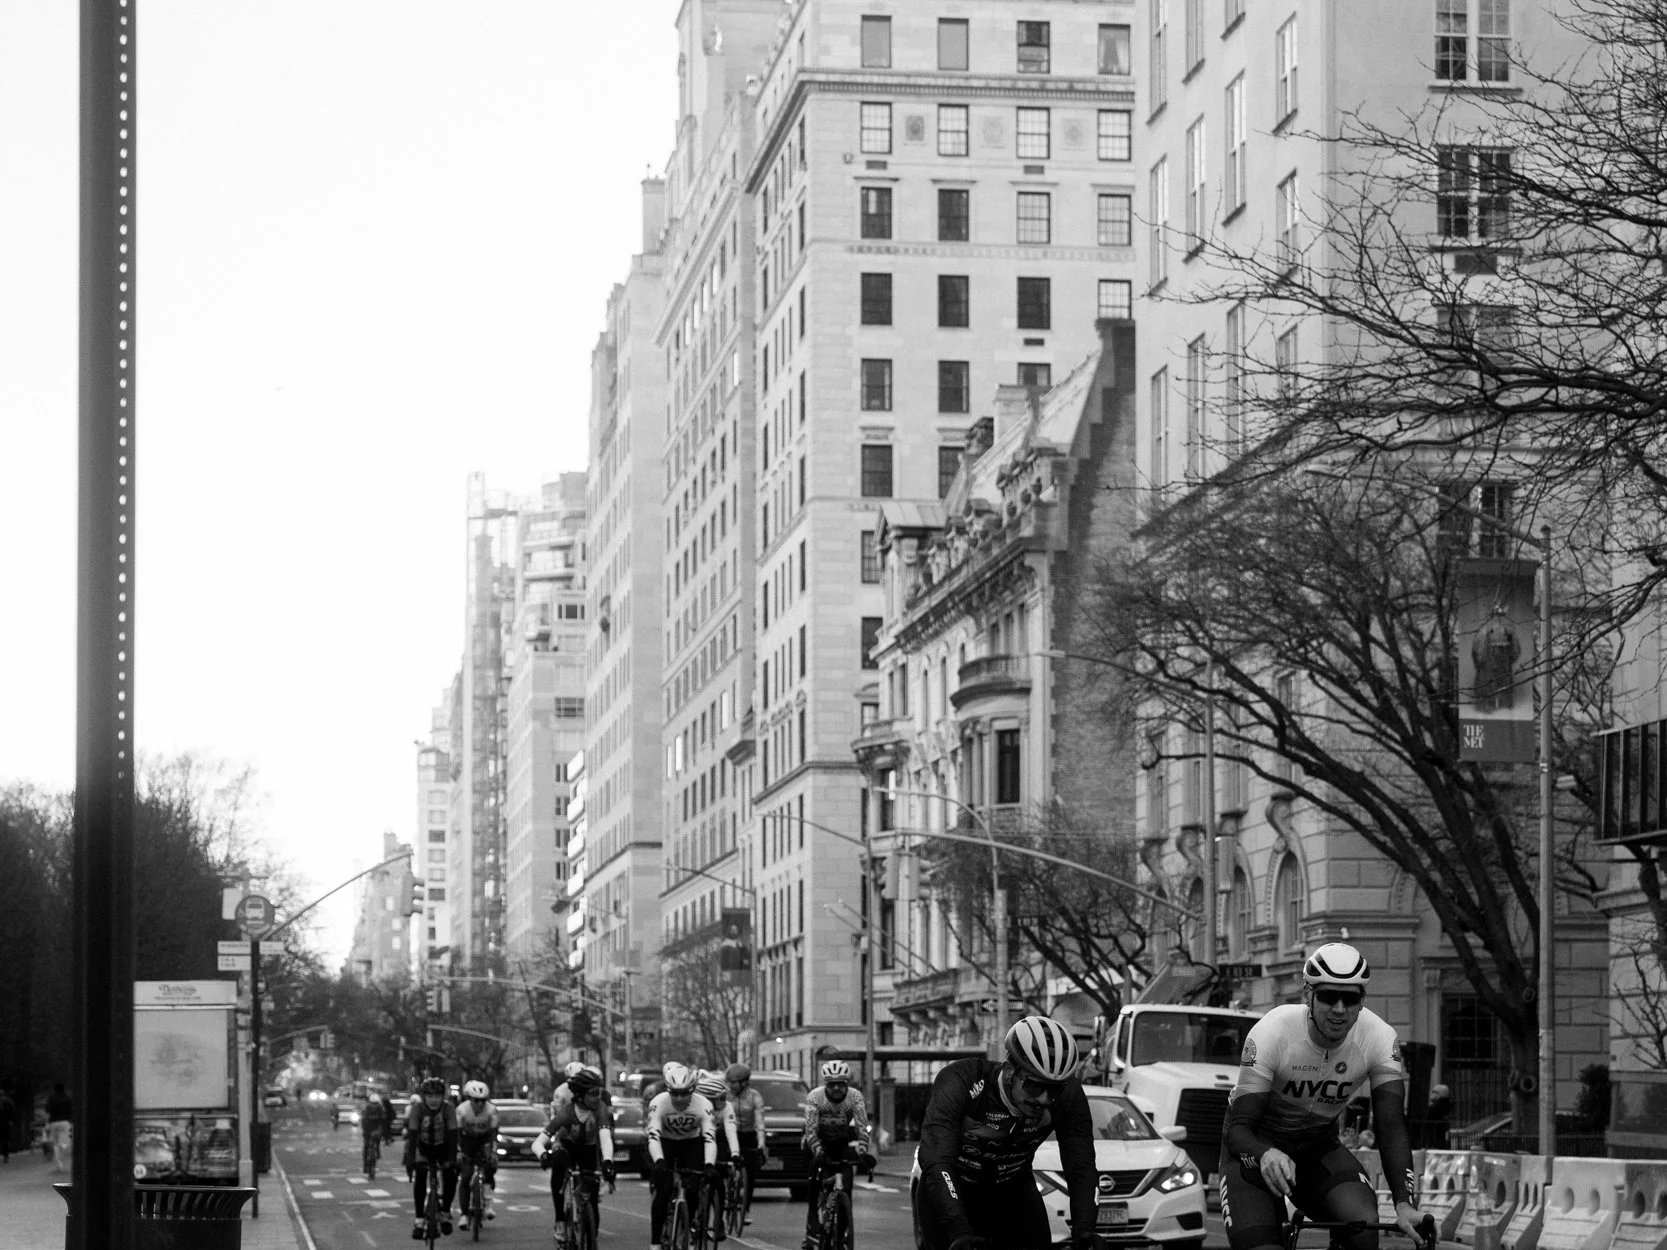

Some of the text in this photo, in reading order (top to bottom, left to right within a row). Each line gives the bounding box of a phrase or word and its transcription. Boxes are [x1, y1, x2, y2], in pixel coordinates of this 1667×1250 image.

[1463, 736, 1485, 749] MET
[1290, 1065, 1319, 1073] MAGEN
[1282, 1080, 1354, 1100] NYCC
